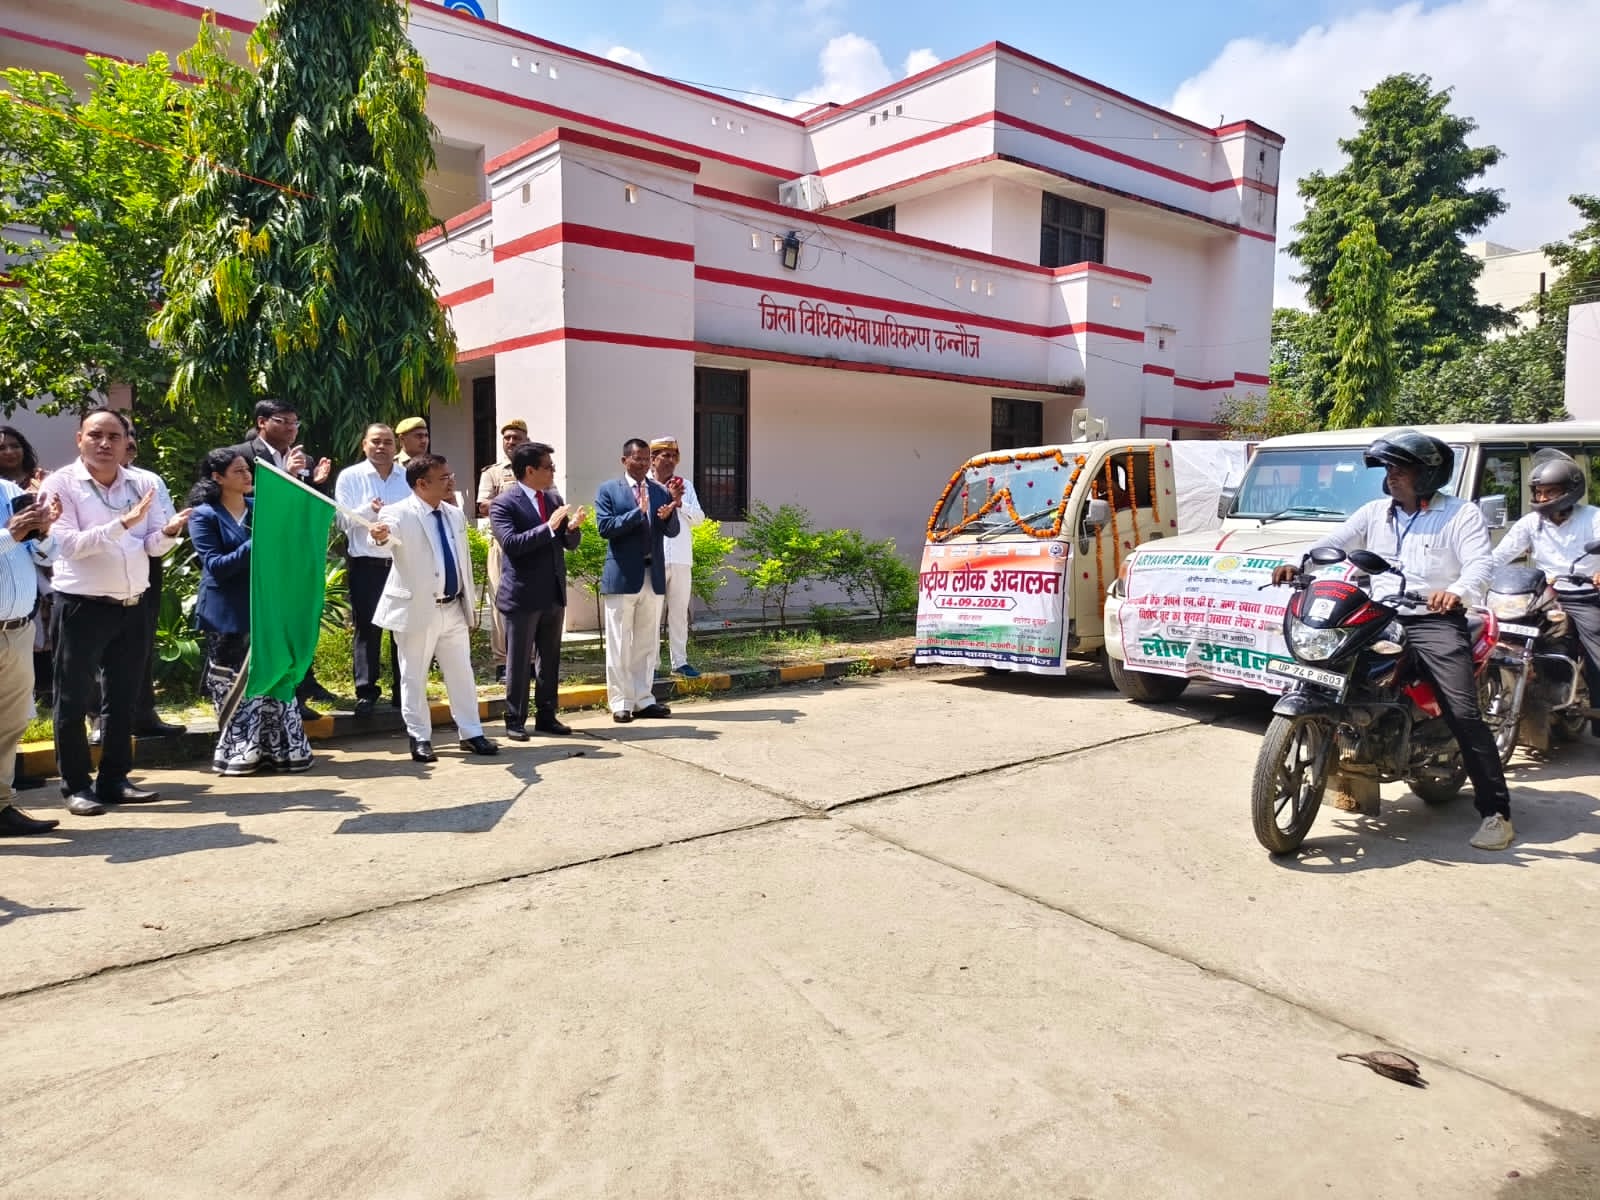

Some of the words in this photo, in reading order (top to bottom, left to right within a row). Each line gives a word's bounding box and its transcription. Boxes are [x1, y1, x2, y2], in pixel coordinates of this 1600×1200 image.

[758, 294, 796, 334] जिला
[872, 315, 931, 353] प्राधिकरण
[933, 324, 981, 359] कन्नौज
[1135, 554, 1184, 567] ARYAVART
[1183, 554, 1214, 567] BANK
[952, 562, 988, 593] लोक
[990, 569, 1062, 595] अदालत
[940, 597, 1006, 609] 14.09.2024
[1139, 634, 1191, 659] लोक
[1278, 663, 1290, 672] UP
[1293, 666, 1305, 677] 74
[1306, 670, 1314, 678] P
[1316, 673, 1342, 685] 8603
